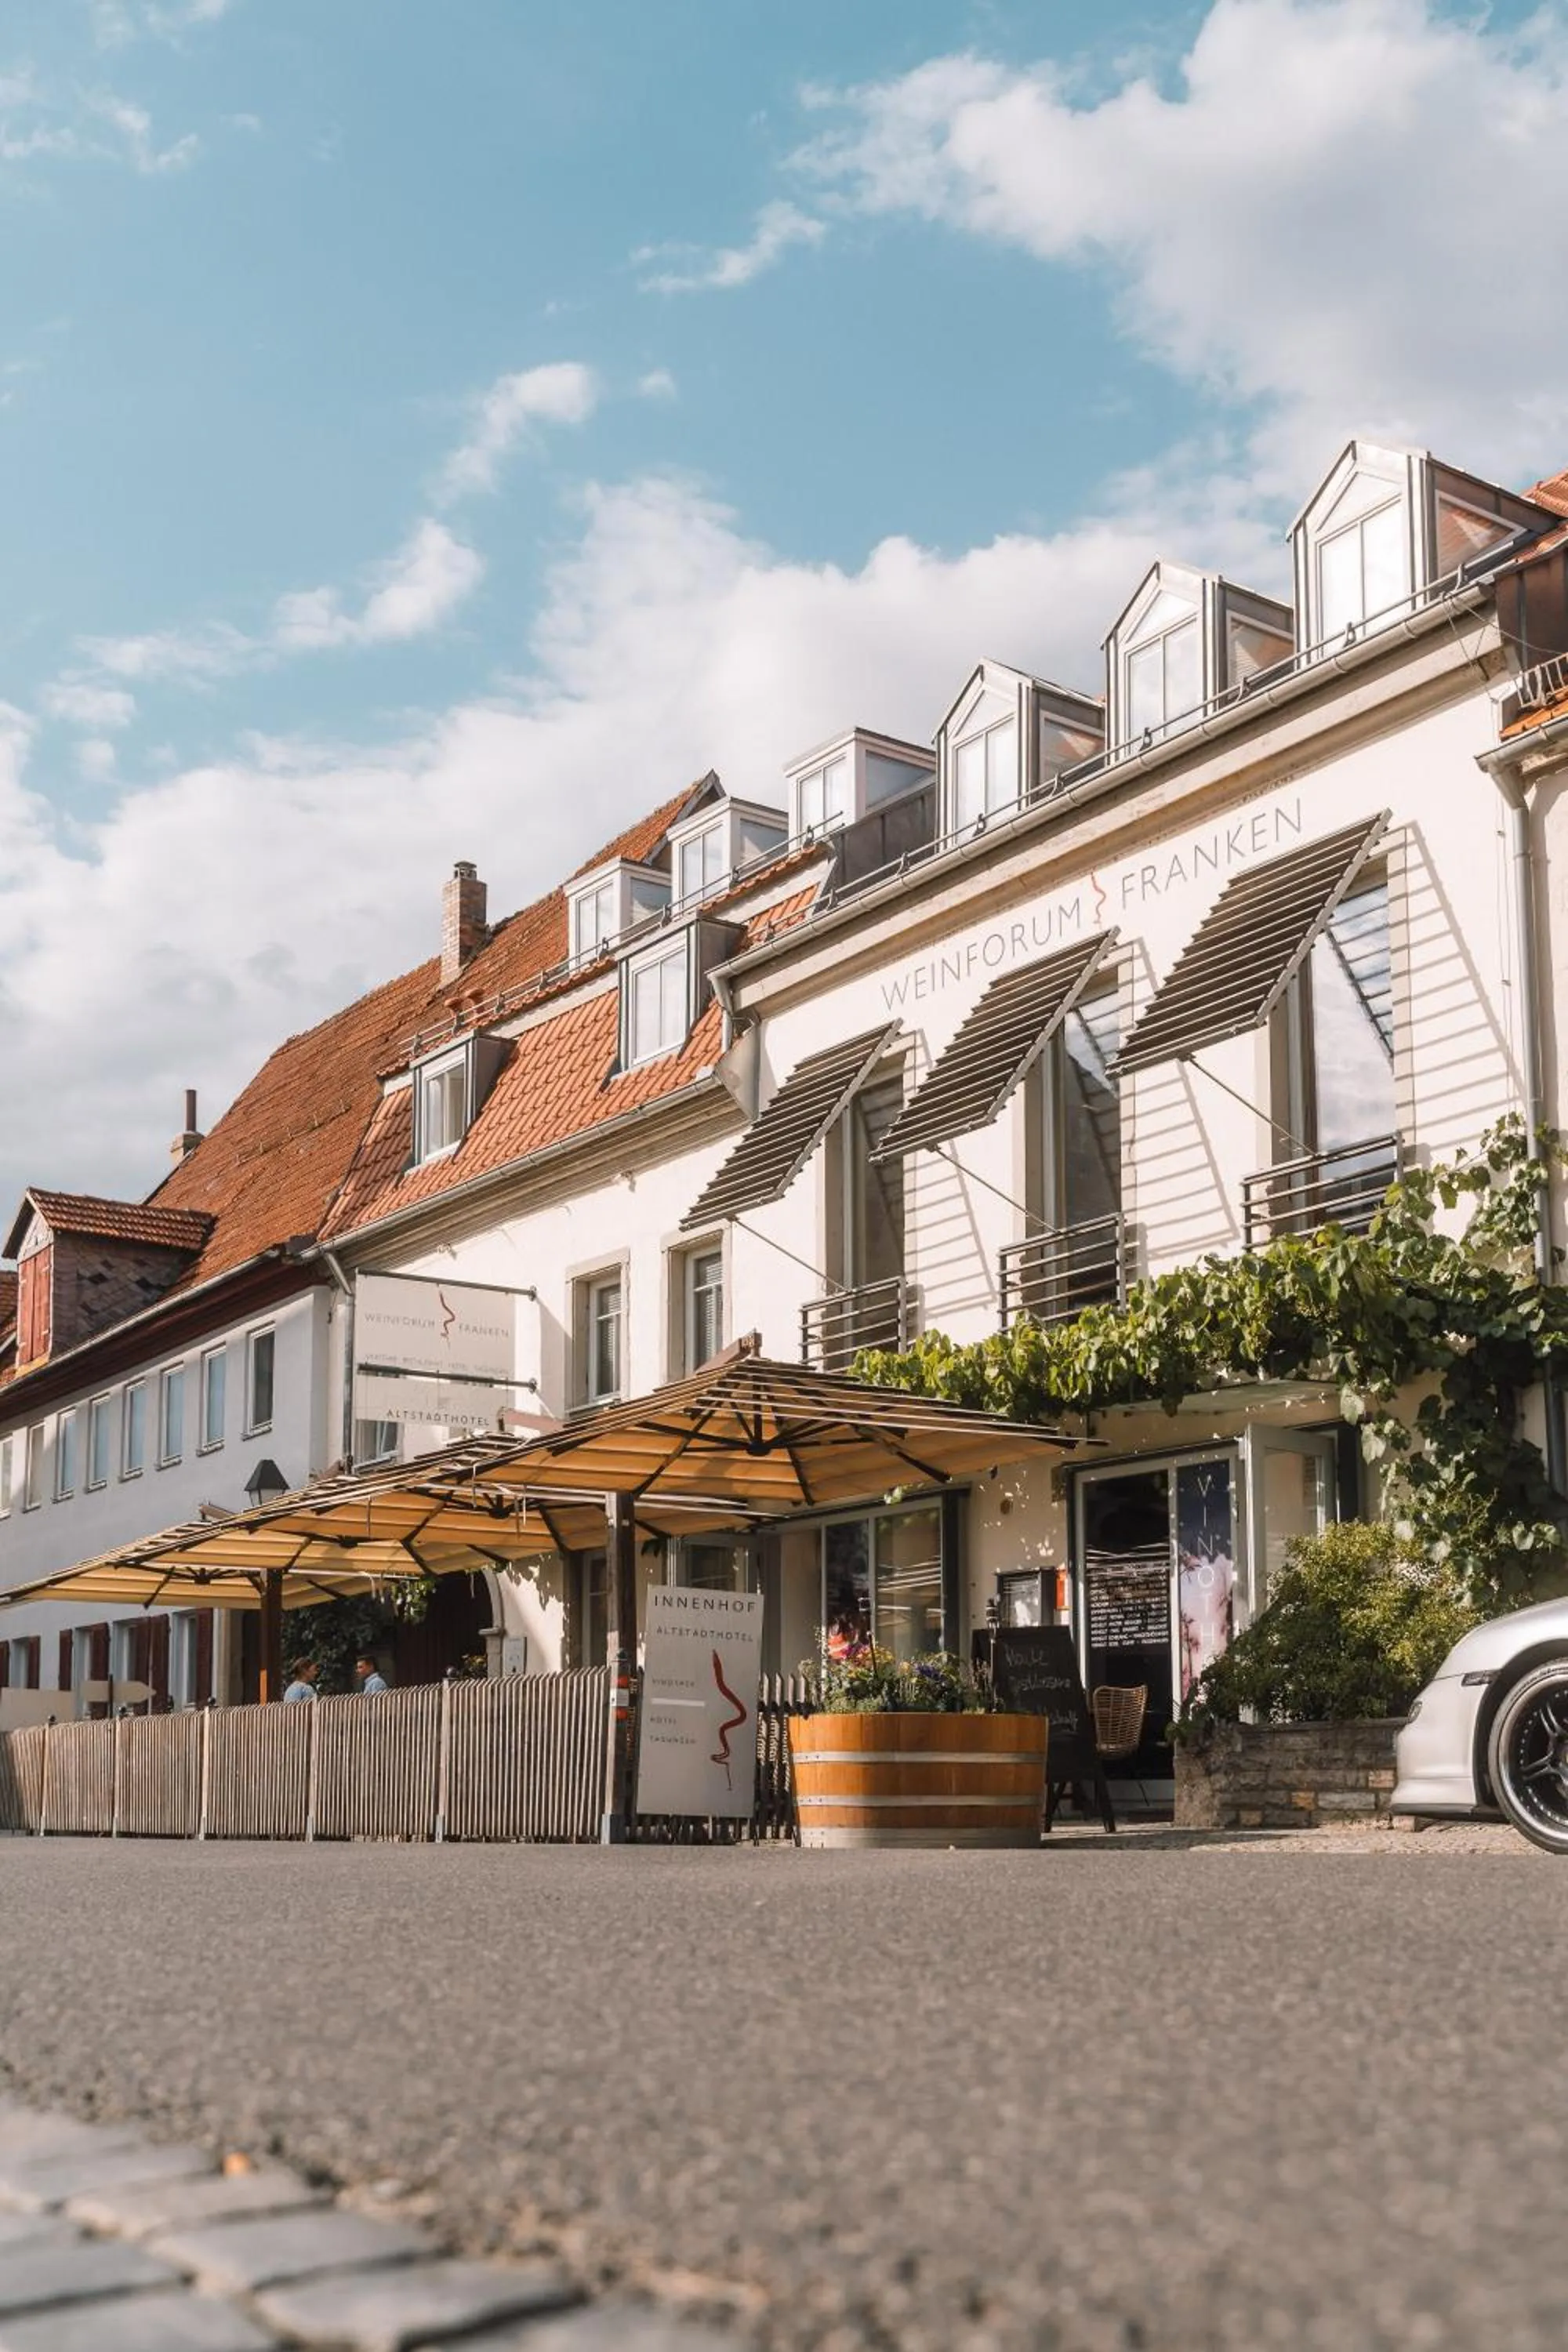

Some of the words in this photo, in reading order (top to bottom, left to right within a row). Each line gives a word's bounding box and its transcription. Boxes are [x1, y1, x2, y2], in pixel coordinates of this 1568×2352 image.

[880, 898, 1081, 1011] WEINFORUM
[1121, 797, 1304, 909] FRANKEN
[364, 1312, 435, 1328] WEINFORUM
[459, 1323, 509, 1338] FRANKEN
[387, 1409, 490, 1426] ALTSTADTHOTEL
[654, 1595, 757, 1613] INNENHOF
[655, 1625, 754, 1642] ALTSTADTHOTEL
